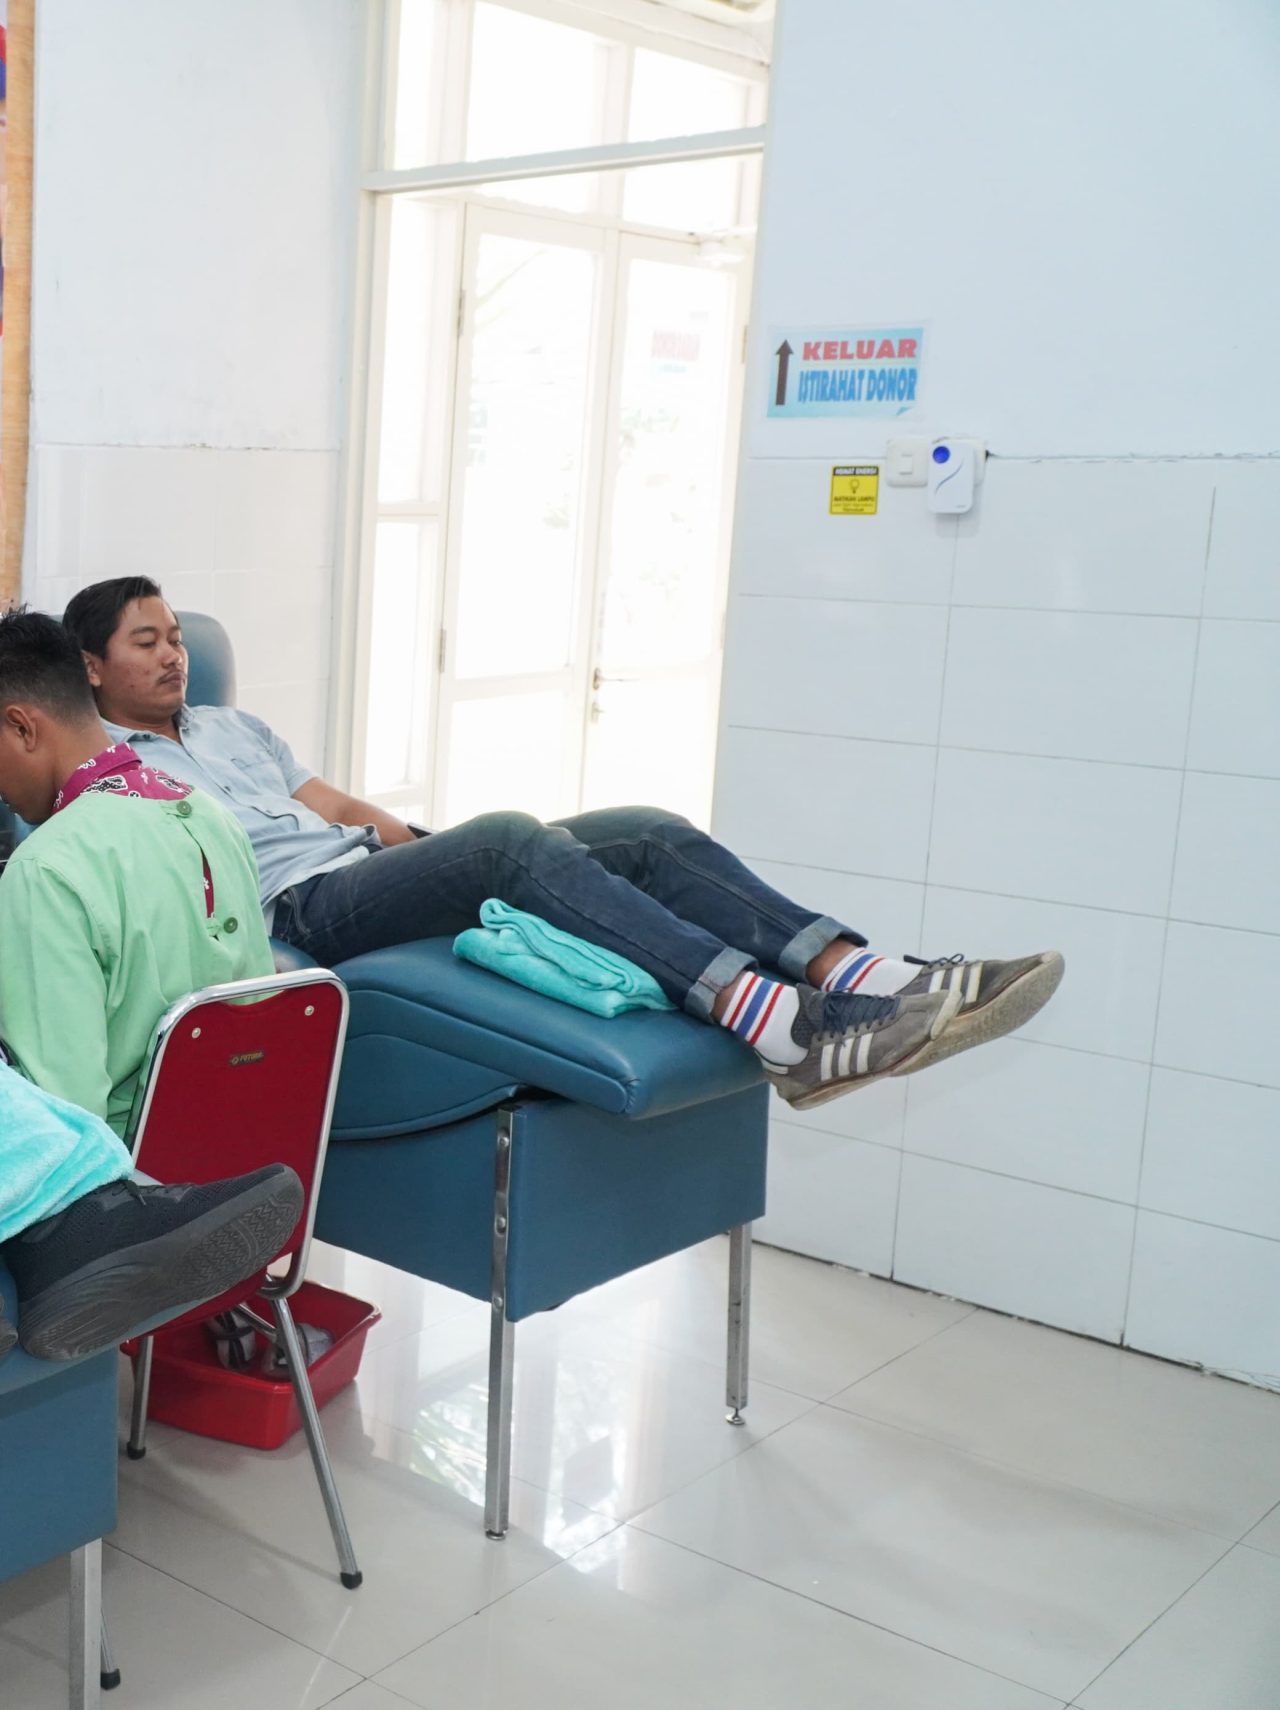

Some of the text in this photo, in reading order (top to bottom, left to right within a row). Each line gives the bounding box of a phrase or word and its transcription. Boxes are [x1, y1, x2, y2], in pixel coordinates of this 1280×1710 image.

[803, 339, 917, 360] KELUAR
[798, 368, 917, 403] ISTIRAHAT DONOR
